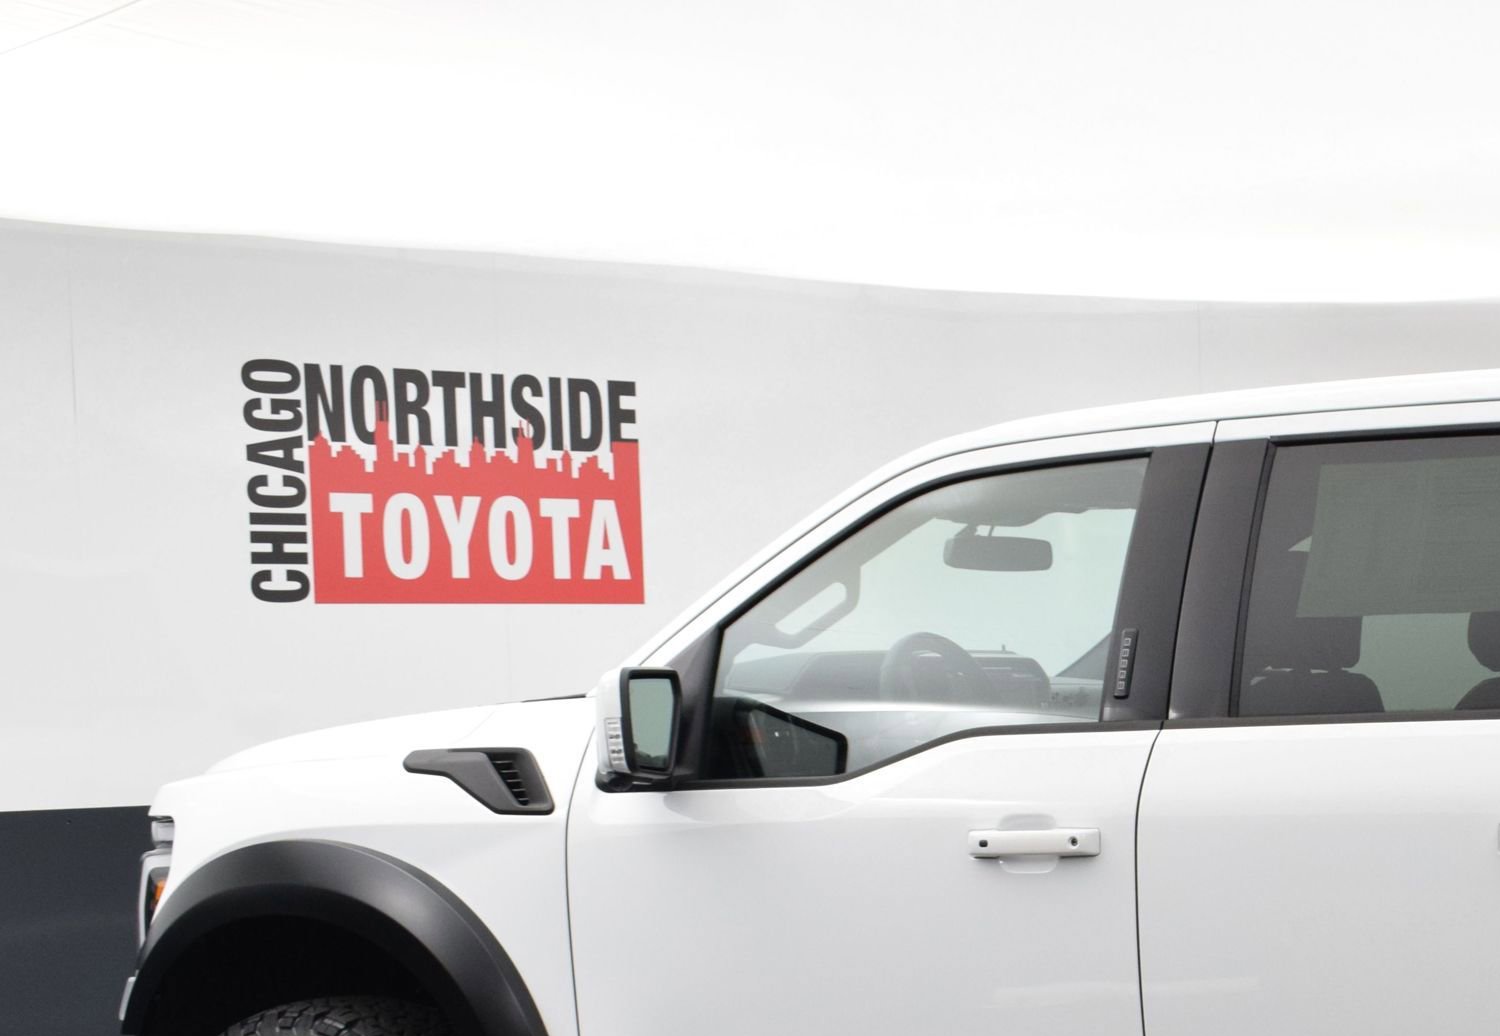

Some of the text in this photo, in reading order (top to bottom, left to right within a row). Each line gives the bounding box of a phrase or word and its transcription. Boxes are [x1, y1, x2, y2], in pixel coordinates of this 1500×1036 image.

[303, 362, 640, 453] NORTHSIDE
[240, 358, 311, 603] CHICAGO
[328, 491, 632, 581] TOYOTA
